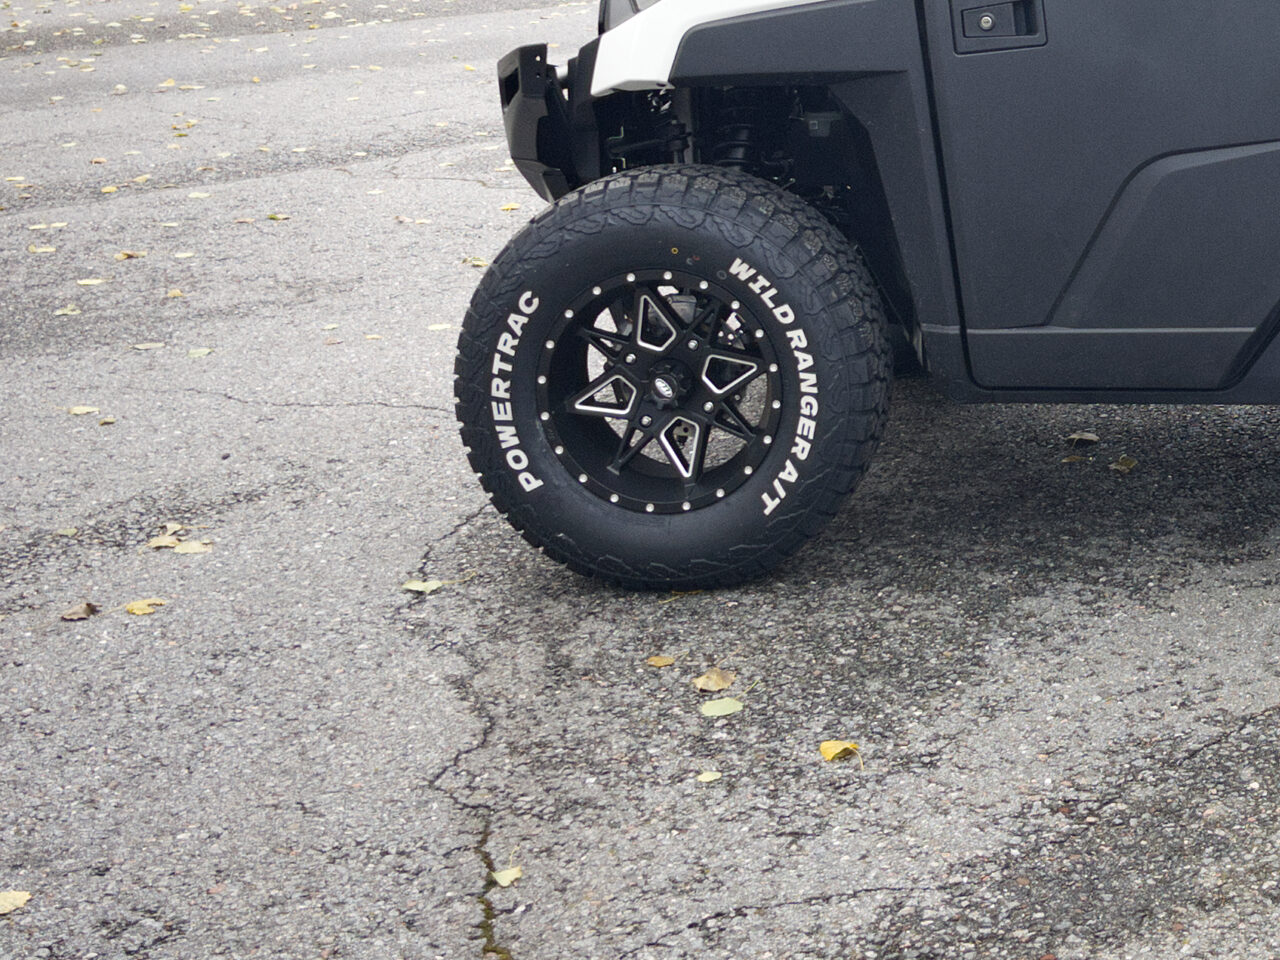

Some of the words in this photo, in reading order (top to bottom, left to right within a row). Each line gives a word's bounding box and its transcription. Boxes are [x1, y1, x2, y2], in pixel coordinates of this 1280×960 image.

[729, 257, 795, 325] WILD
[491, 290, 544, 493] POWERTRAC
[785, 328, 819, 461] RANGER
[760, 458, 799, 516] A/T
